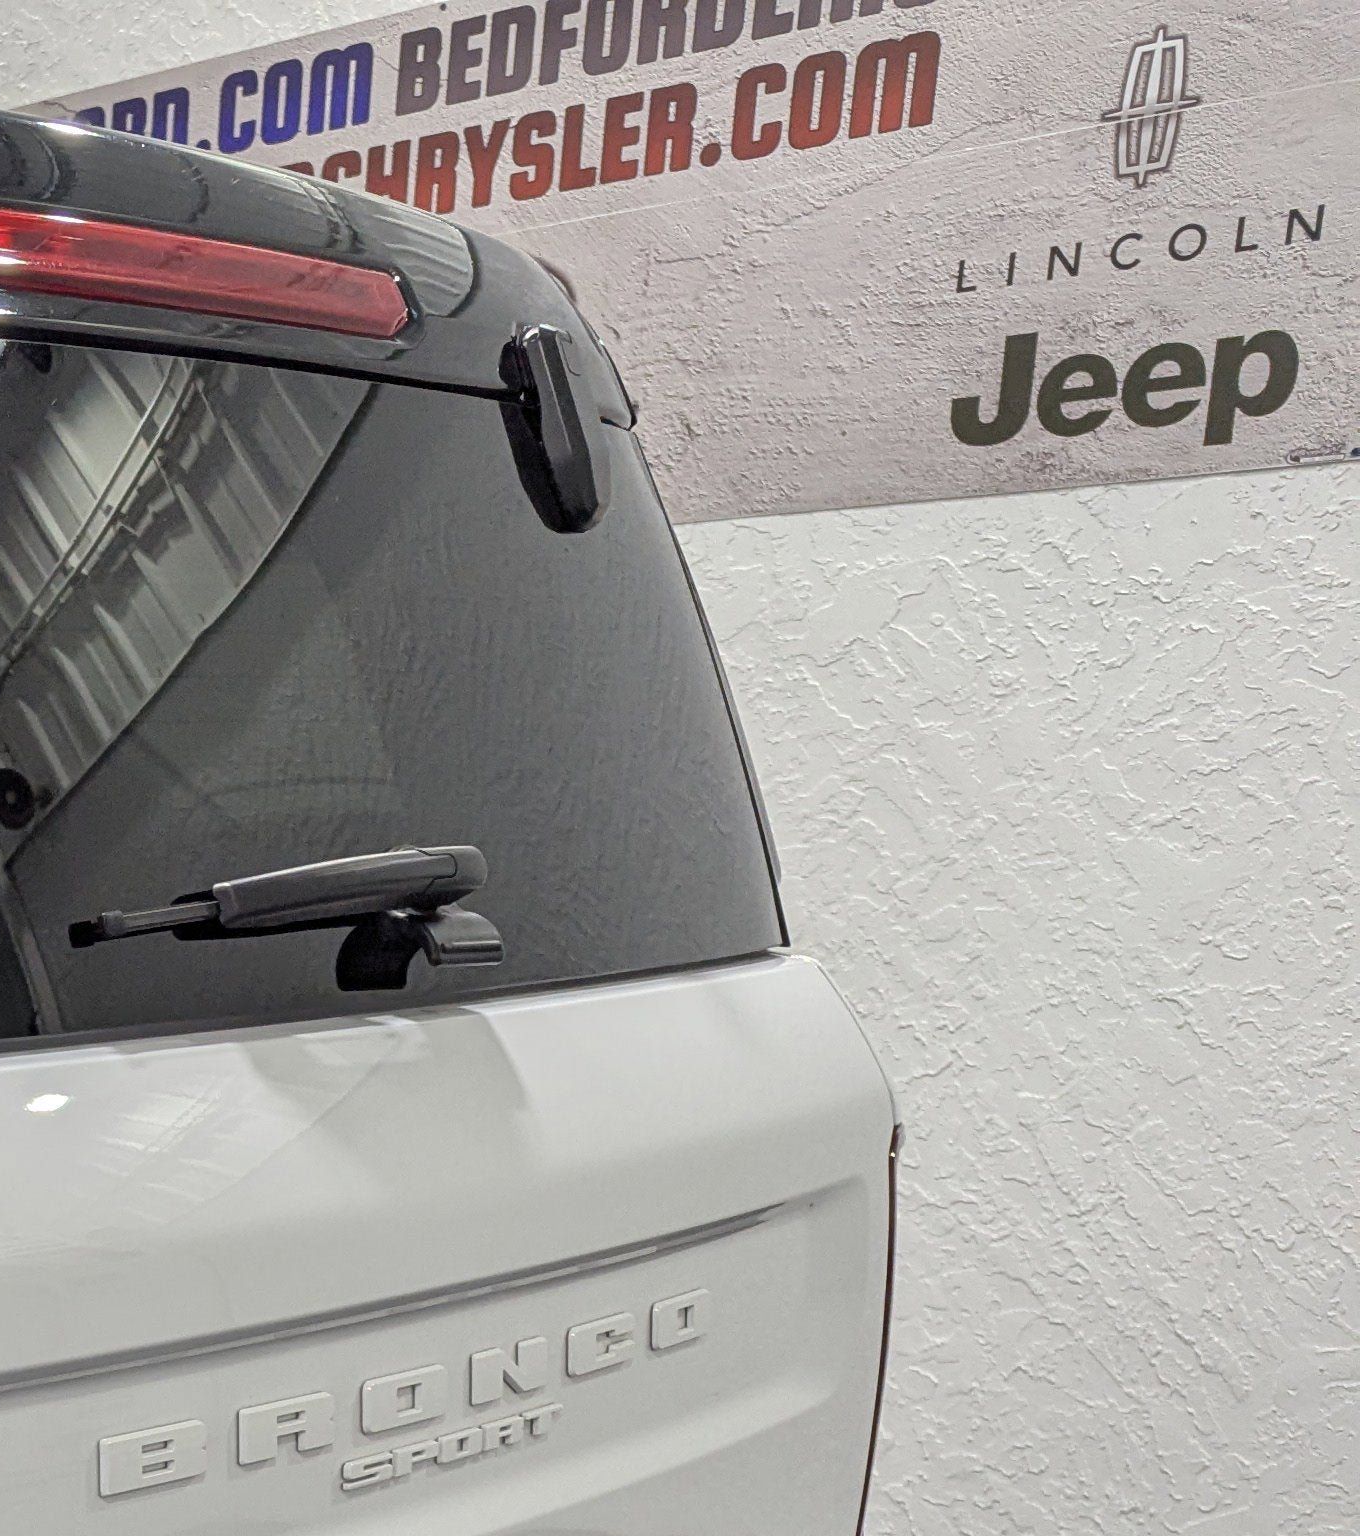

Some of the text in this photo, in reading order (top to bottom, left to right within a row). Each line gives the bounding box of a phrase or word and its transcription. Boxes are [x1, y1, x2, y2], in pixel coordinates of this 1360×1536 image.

[955, 204, 1326, 293] LINCOLN
[951, 330, 1299, 447] Jeep
[98, 1288, 712, 1498] BRONCO
[341, 1402, 565, 1491] SPORT
